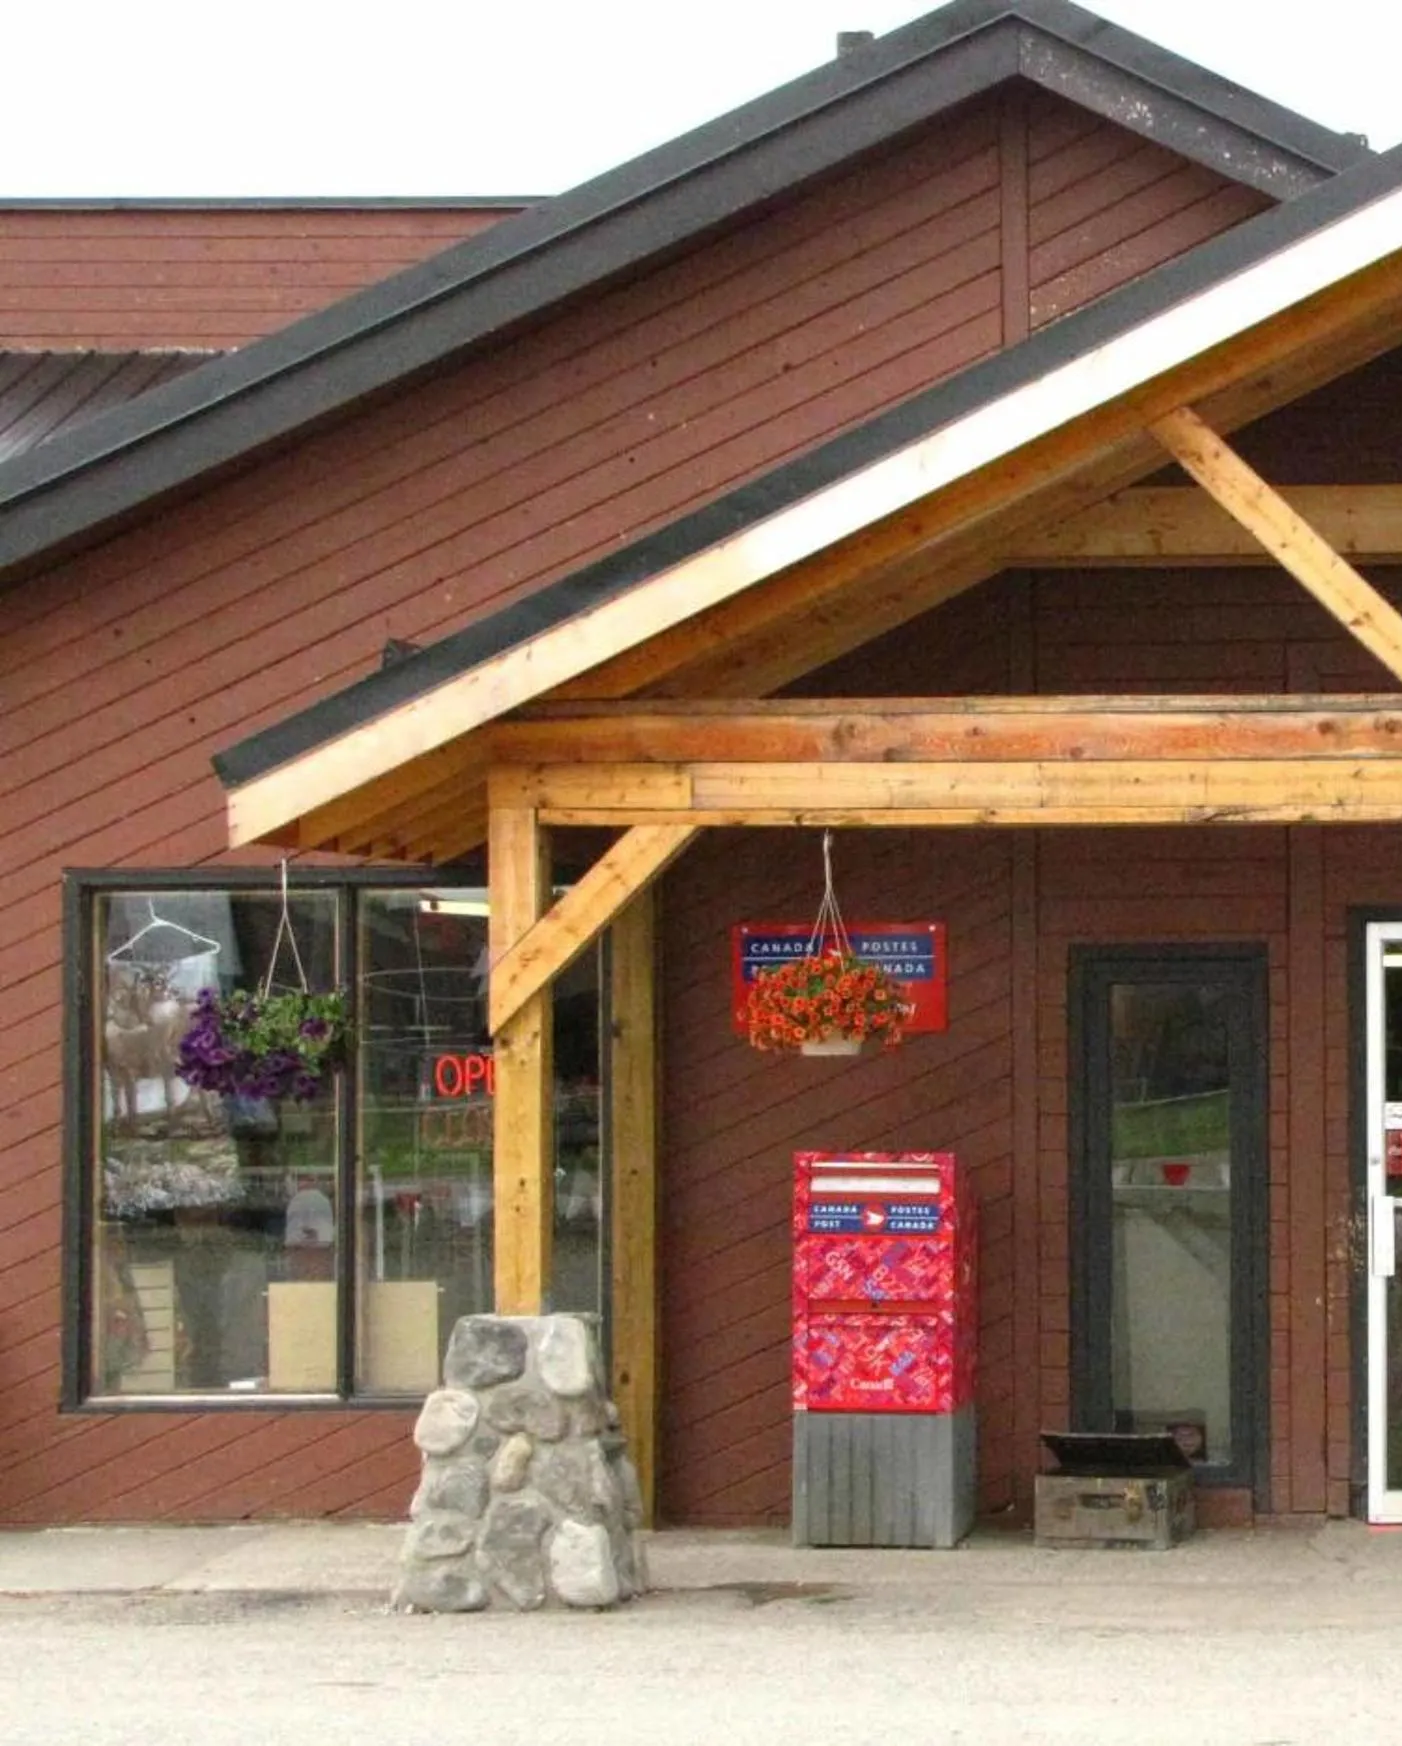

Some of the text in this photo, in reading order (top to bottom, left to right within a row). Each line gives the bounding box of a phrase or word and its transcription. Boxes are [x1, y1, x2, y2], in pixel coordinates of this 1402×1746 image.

[750, 941, 814, 954] CANADA
[861, 940, 918, 953] POSTES
[875, 961, 926, 975] NADA
[813, 1204, 857, 1213] CANADA
[890, 1205, 930, 1215] POSTES
[813, 1220, 841, 1228] POST
[889, 1221, 935, 1230] CANADA
